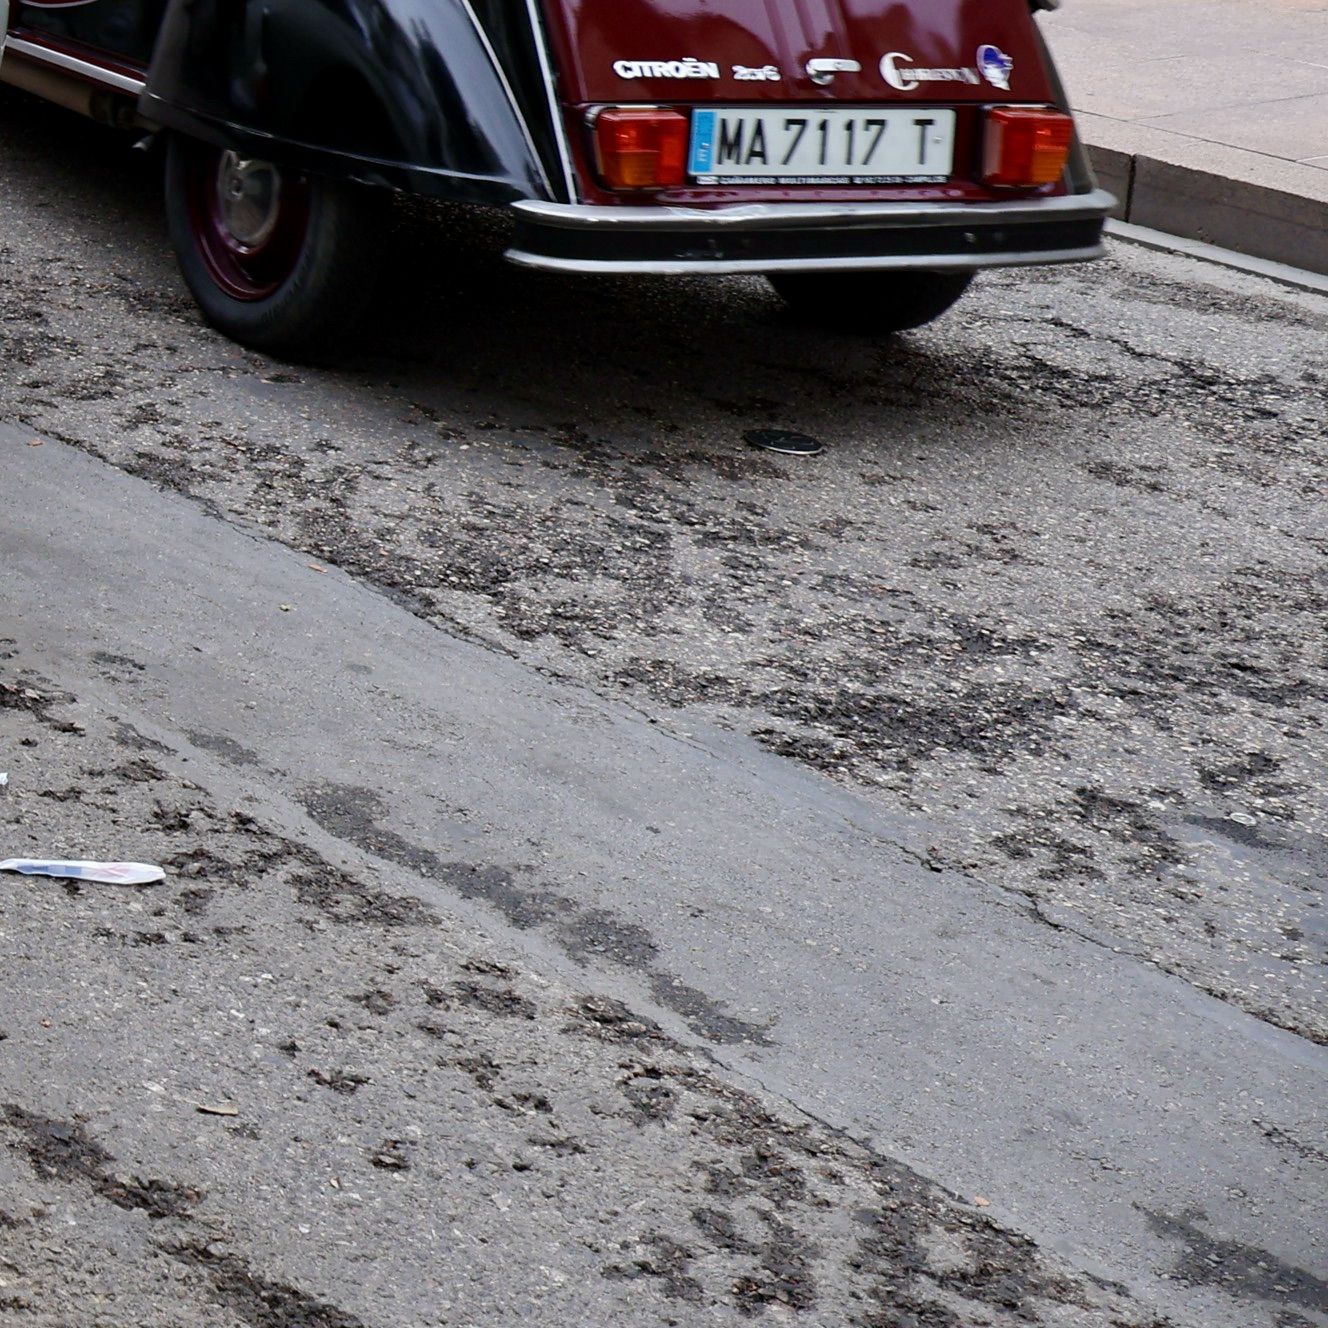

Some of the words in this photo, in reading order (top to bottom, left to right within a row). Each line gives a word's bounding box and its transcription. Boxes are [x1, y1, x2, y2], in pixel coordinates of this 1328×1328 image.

[717, 118, 769, 166] MA
[781, 118, 888, 166] 7117
[913, 118, 936, 165] T
